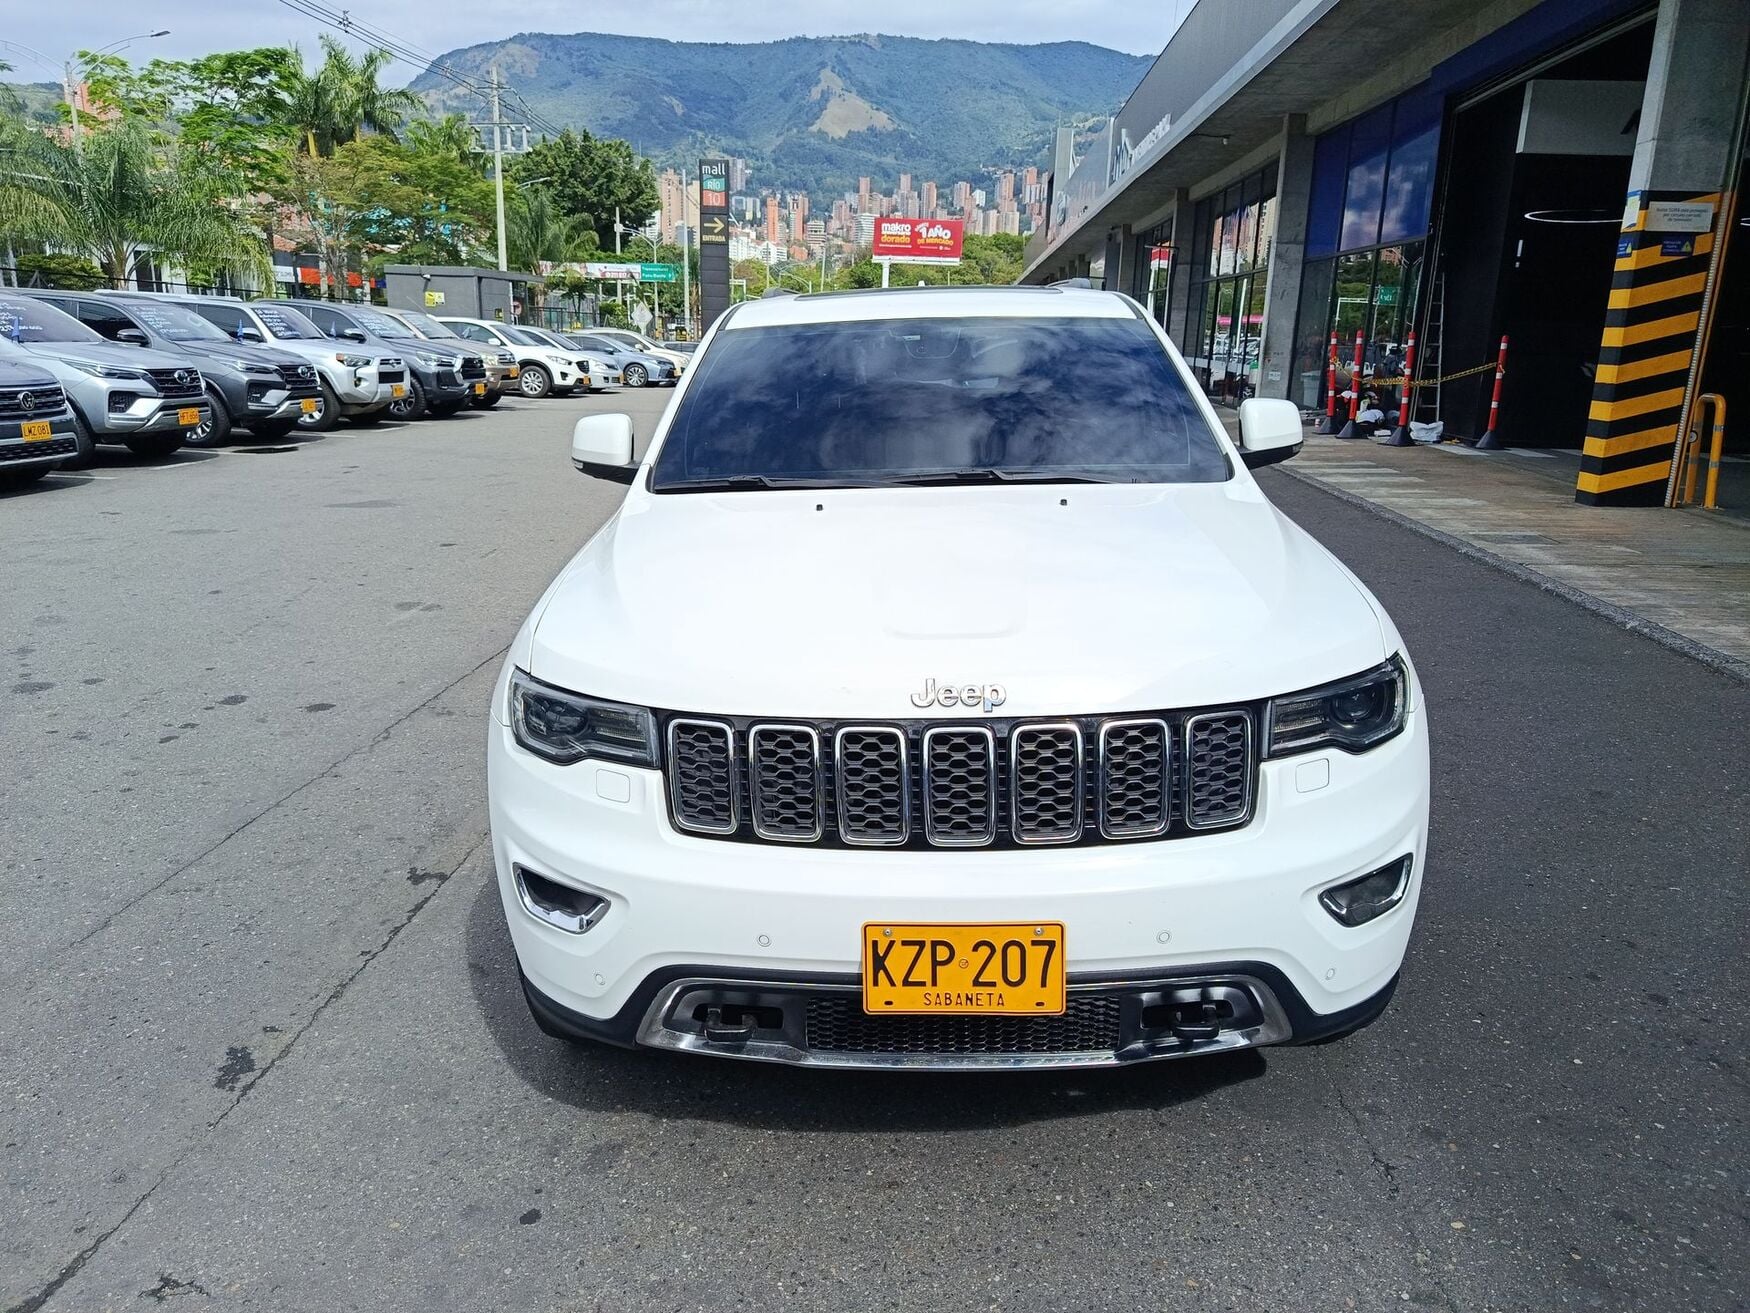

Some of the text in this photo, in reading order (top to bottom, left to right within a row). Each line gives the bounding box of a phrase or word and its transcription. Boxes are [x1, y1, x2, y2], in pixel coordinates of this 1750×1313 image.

[702, 163, 726, 175] mall
[707, 193, 721, 205] 10
[881, 222, 912, 232] makro
[928, 224, 951, 239] AÑO
[881, 235, 911, 244] dorado
[911, 678, 1006, 713] Jeep
[871, 939, 1057, 988] KZP 207
[923, 992, 1005, 1007] SABANETA
